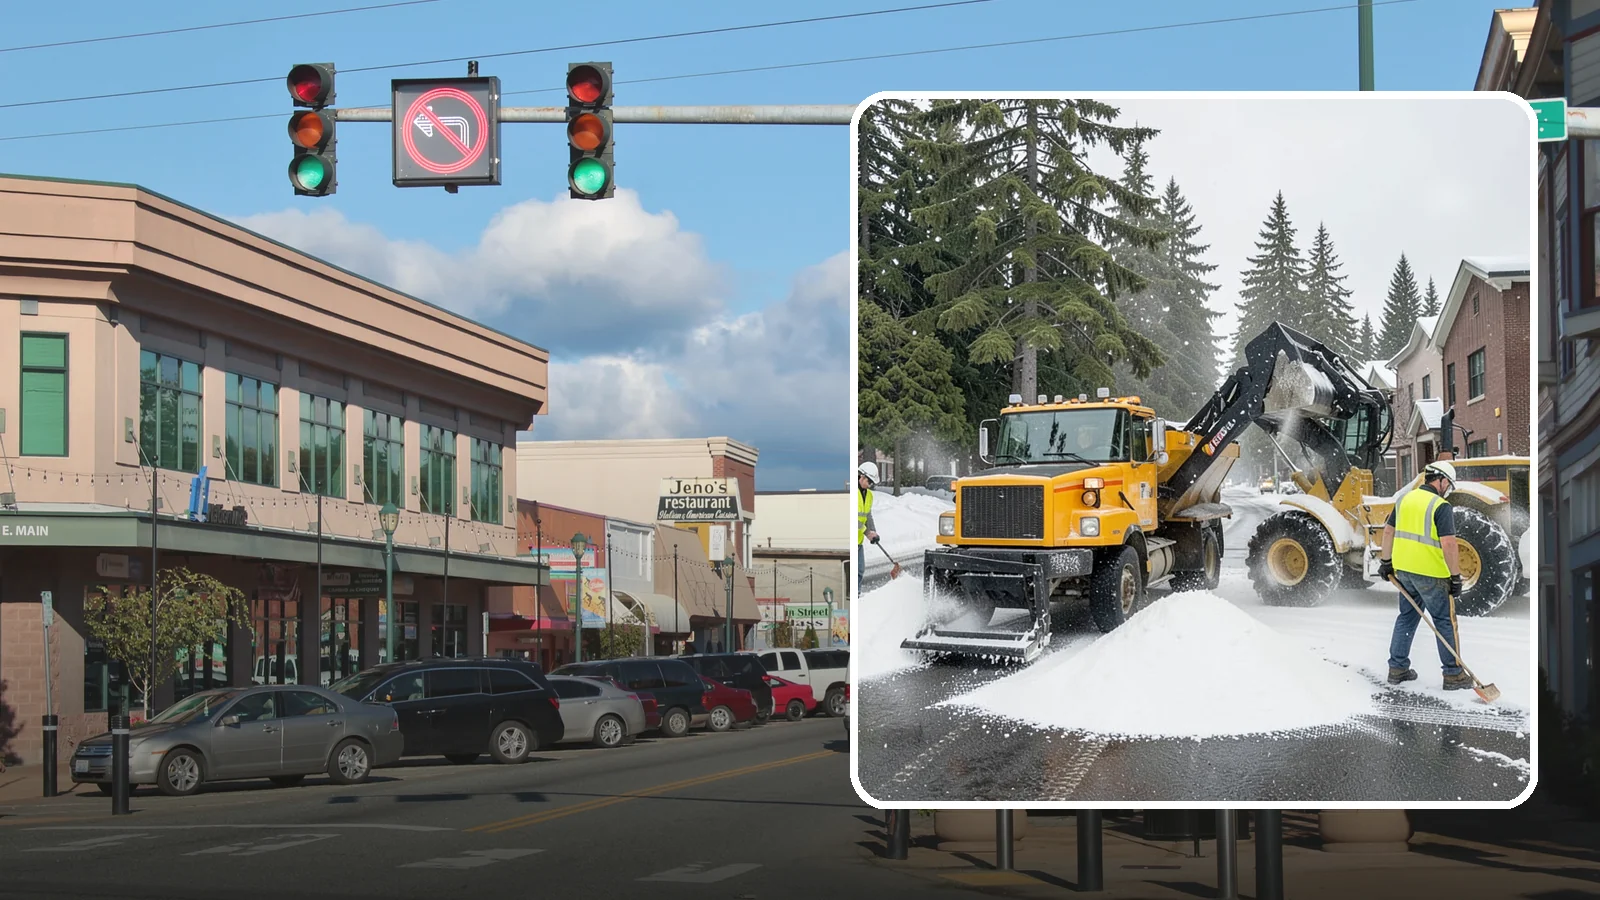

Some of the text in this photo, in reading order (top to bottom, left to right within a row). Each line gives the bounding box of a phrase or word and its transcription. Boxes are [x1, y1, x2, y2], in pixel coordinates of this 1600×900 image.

[669, 480, 727, 494] Jeno's
[665, 496, 731, 509] restaurant
[658, 510, 682, 520] Italian
[686, 510, 714, 520] American
[715, 509, 737, 520] Cuisine
[2, 525, 49, 536] E. MAIN
[797, 607, 829, 617] Street
[791, 619, 824, 627] lass
